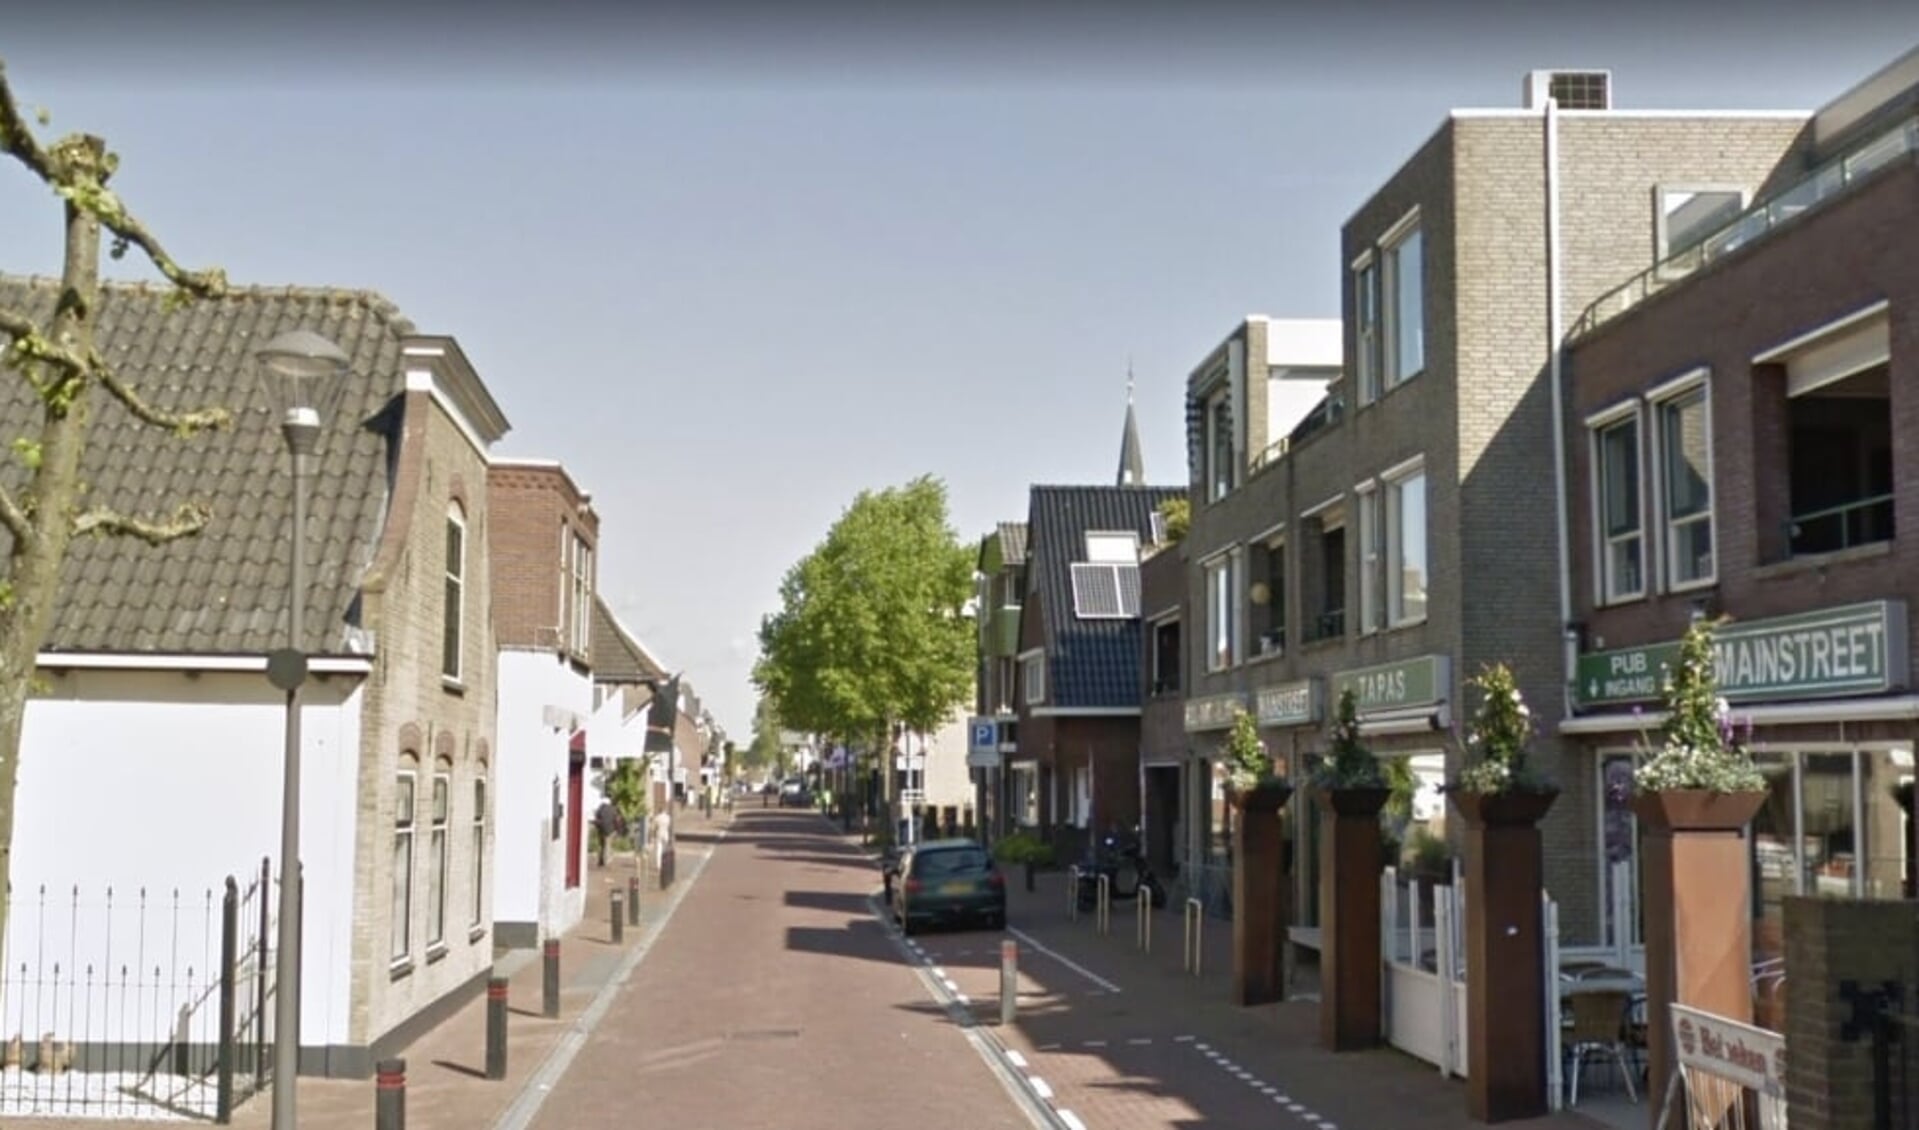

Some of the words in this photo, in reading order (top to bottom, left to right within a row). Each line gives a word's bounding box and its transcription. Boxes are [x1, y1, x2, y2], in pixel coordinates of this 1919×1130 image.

[1611, 652, 1647, 676] PUB
[1714, 622, 1882, 687] MAINSTREET
[1358, 669, 1405, 702] TAPAS
[1604, 676, 1656, 698] INGANG
[976, 726, 989, 745] P
